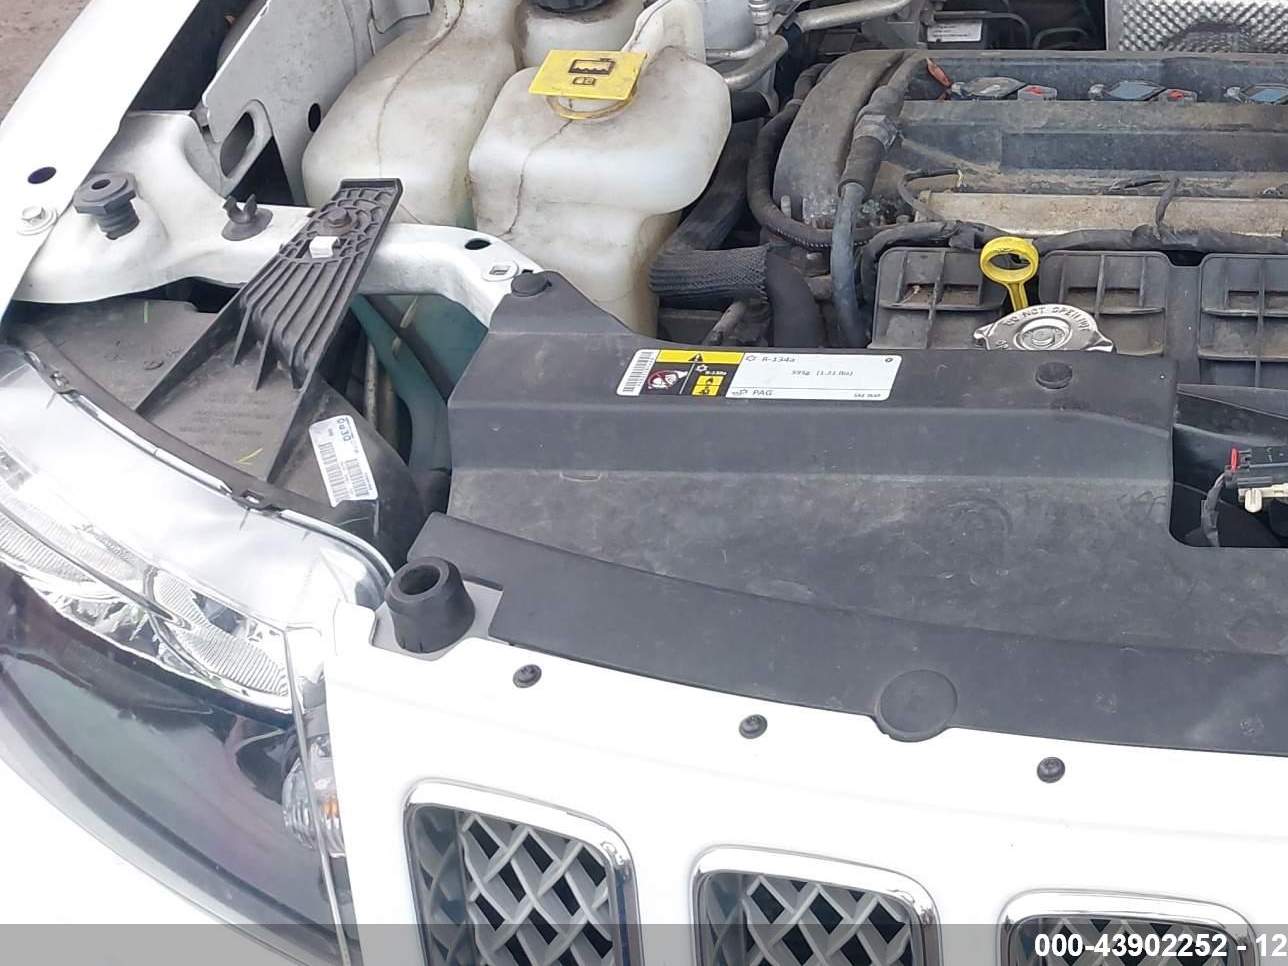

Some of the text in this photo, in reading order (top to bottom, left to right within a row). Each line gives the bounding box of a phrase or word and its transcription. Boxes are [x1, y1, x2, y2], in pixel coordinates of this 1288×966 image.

[1022, 306, 1045, 317] NOT
[761, 355, 796, 364] R-134a
[752, 388, 773, 398] PAG
